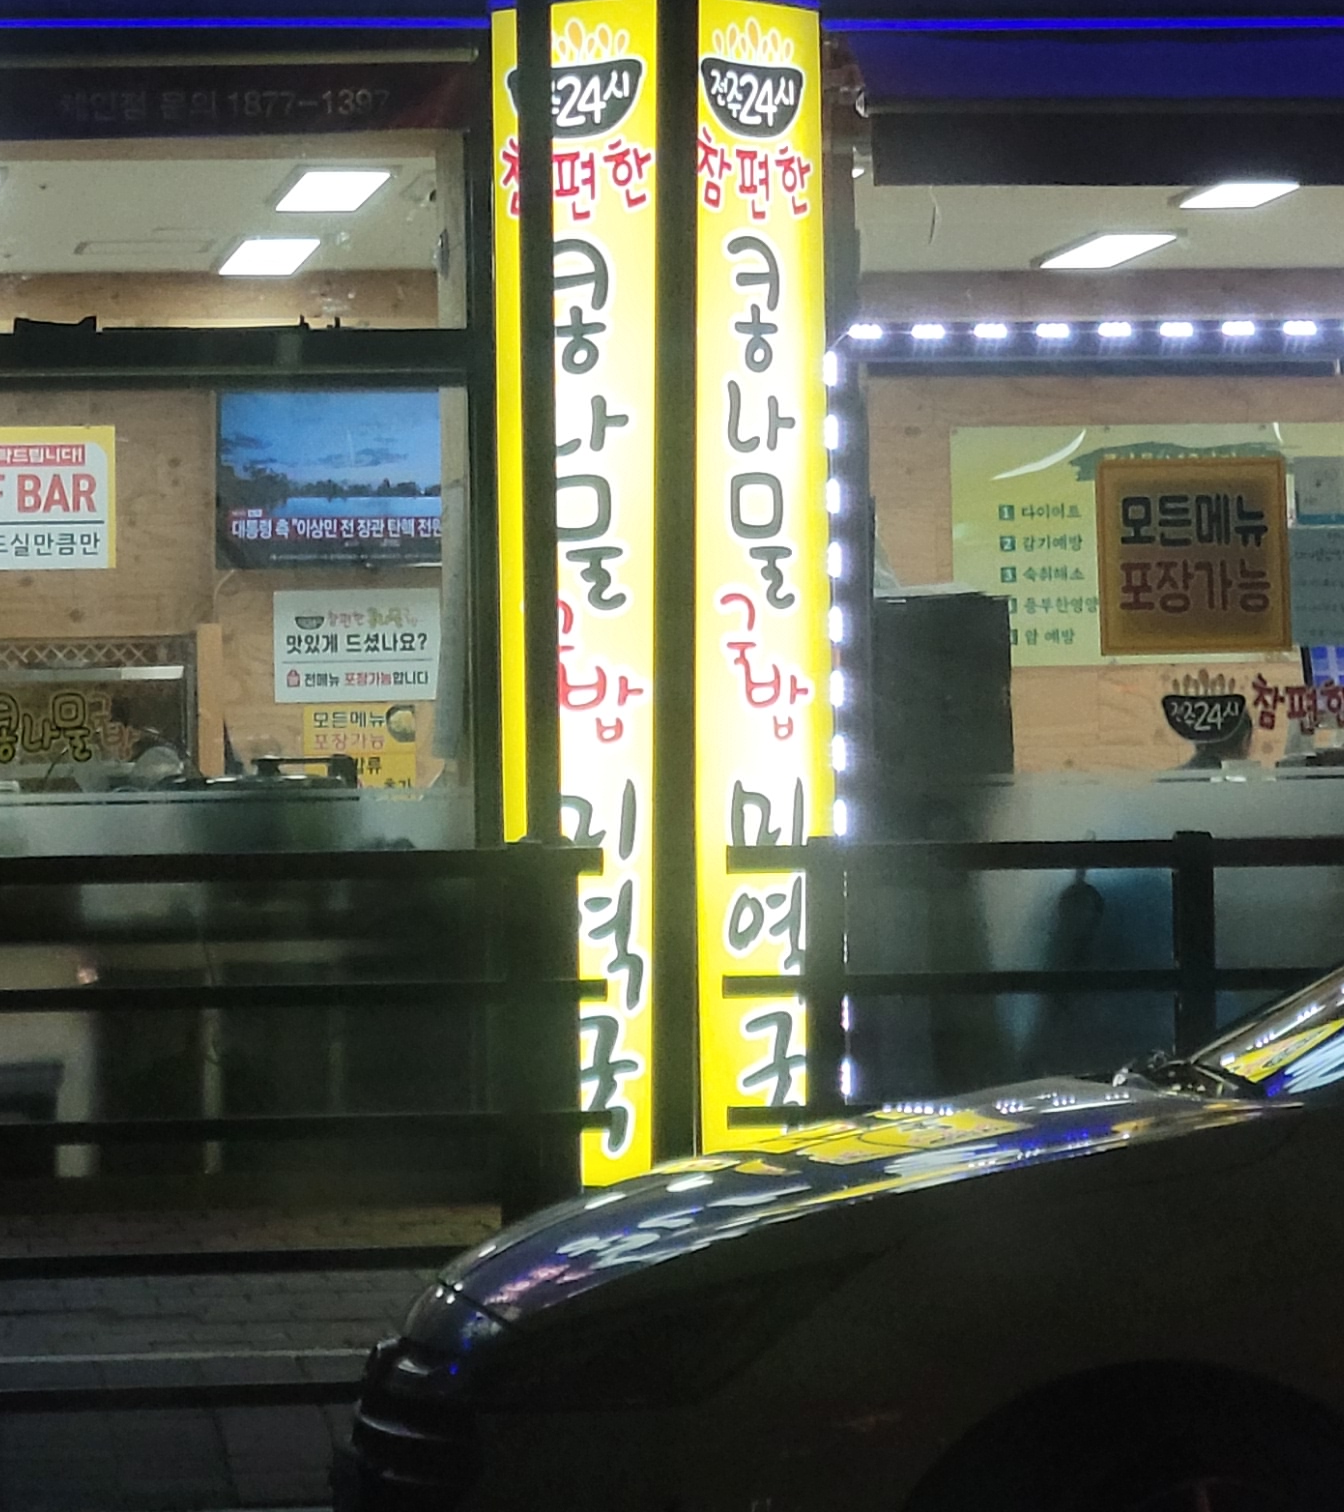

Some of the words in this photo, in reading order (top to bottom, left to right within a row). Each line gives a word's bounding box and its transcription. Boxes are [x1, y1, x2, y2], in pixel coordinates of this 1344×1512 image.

[710, 69, 795, 125] 전주24시
[697, 127, 811, 220] 참편한
[16, 473, 97, 514] BAR
[1120, 492, 1269, 547] 모든메뉴
[1119, 558, 1271, 614] 포장가능
[286, 634, 338, 655] 맛있게
[345, 632, 428, 653] 드셨나요?
[304, 671, 340, 688] 전메뉴
[344, 670, 429, 688] 포장가능합니다
[313, 711, 385, 728] 모든메뉴
